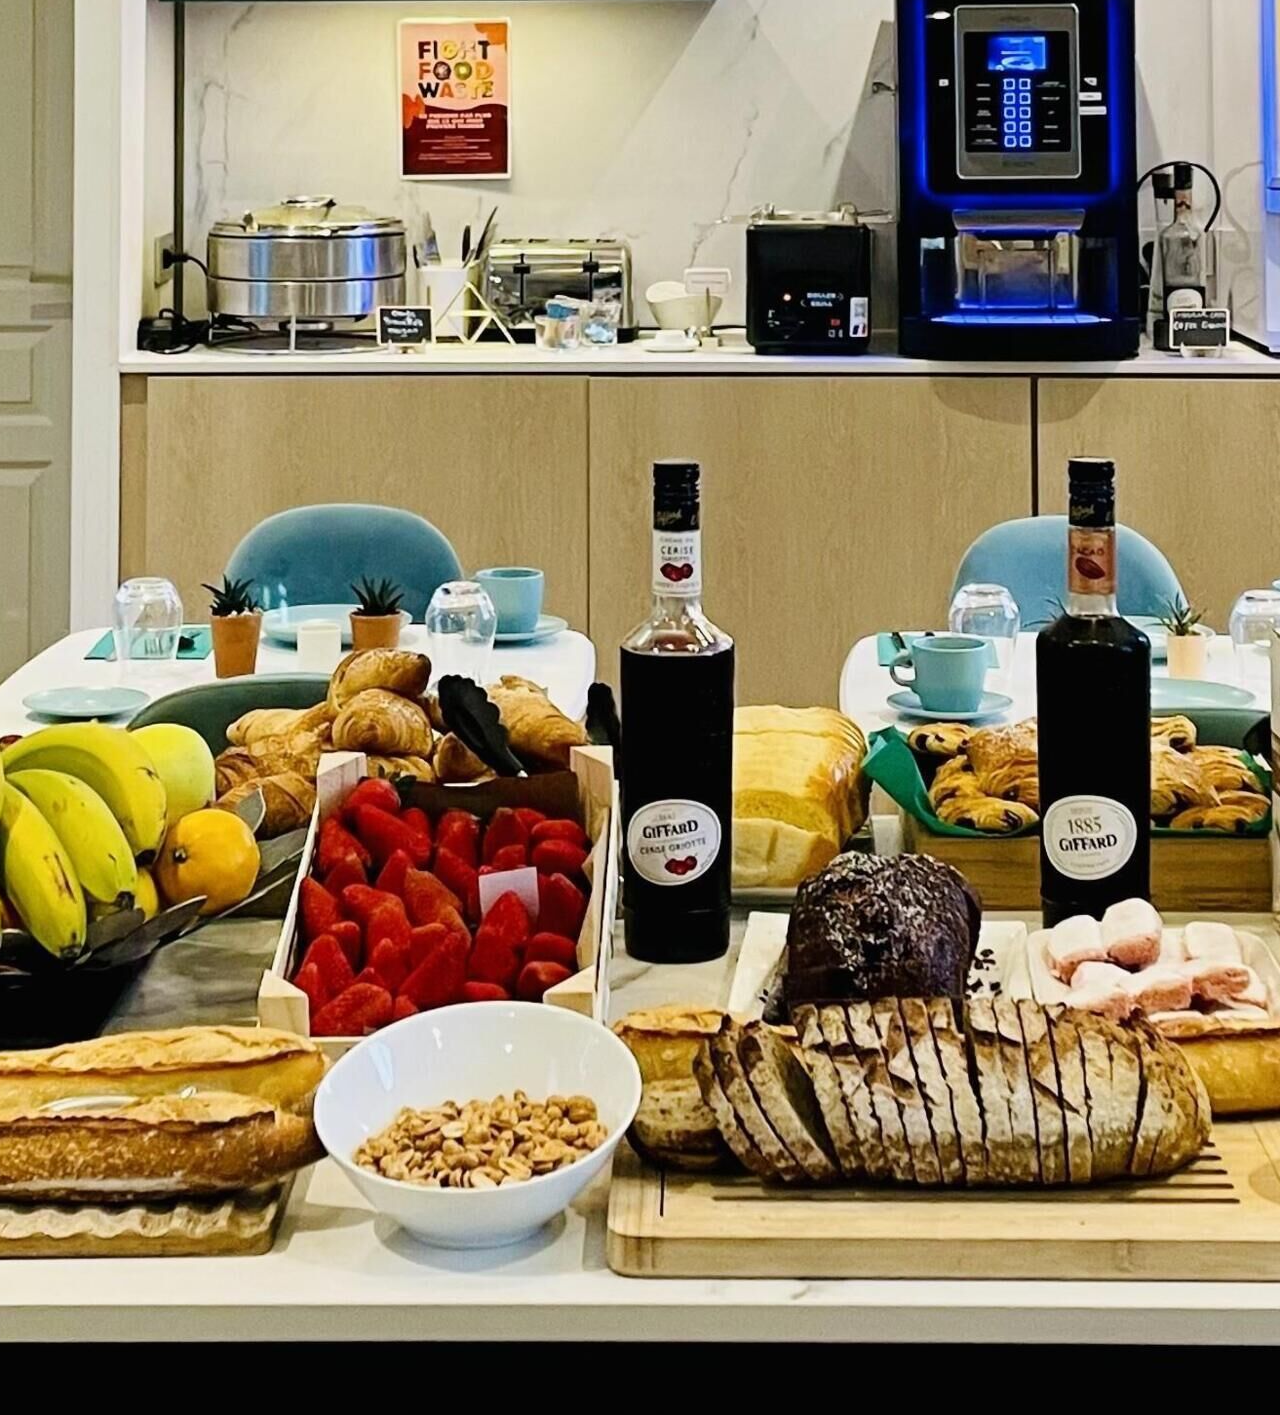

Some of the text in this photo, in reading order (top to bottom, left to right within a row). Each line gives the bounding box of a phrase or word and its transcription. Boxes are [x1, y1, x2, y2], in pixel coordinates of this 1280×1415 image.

[418, 40, 491, 60] FIGHT
[418, 61, 494, 81] FOOD
[418, 81, 494, 99] WASTE
[642, 819, 699, 839] GIFFARD
[1068, 815, 1102, 835] 1885
[1059, 834, 1118, 852] GIFFARD
